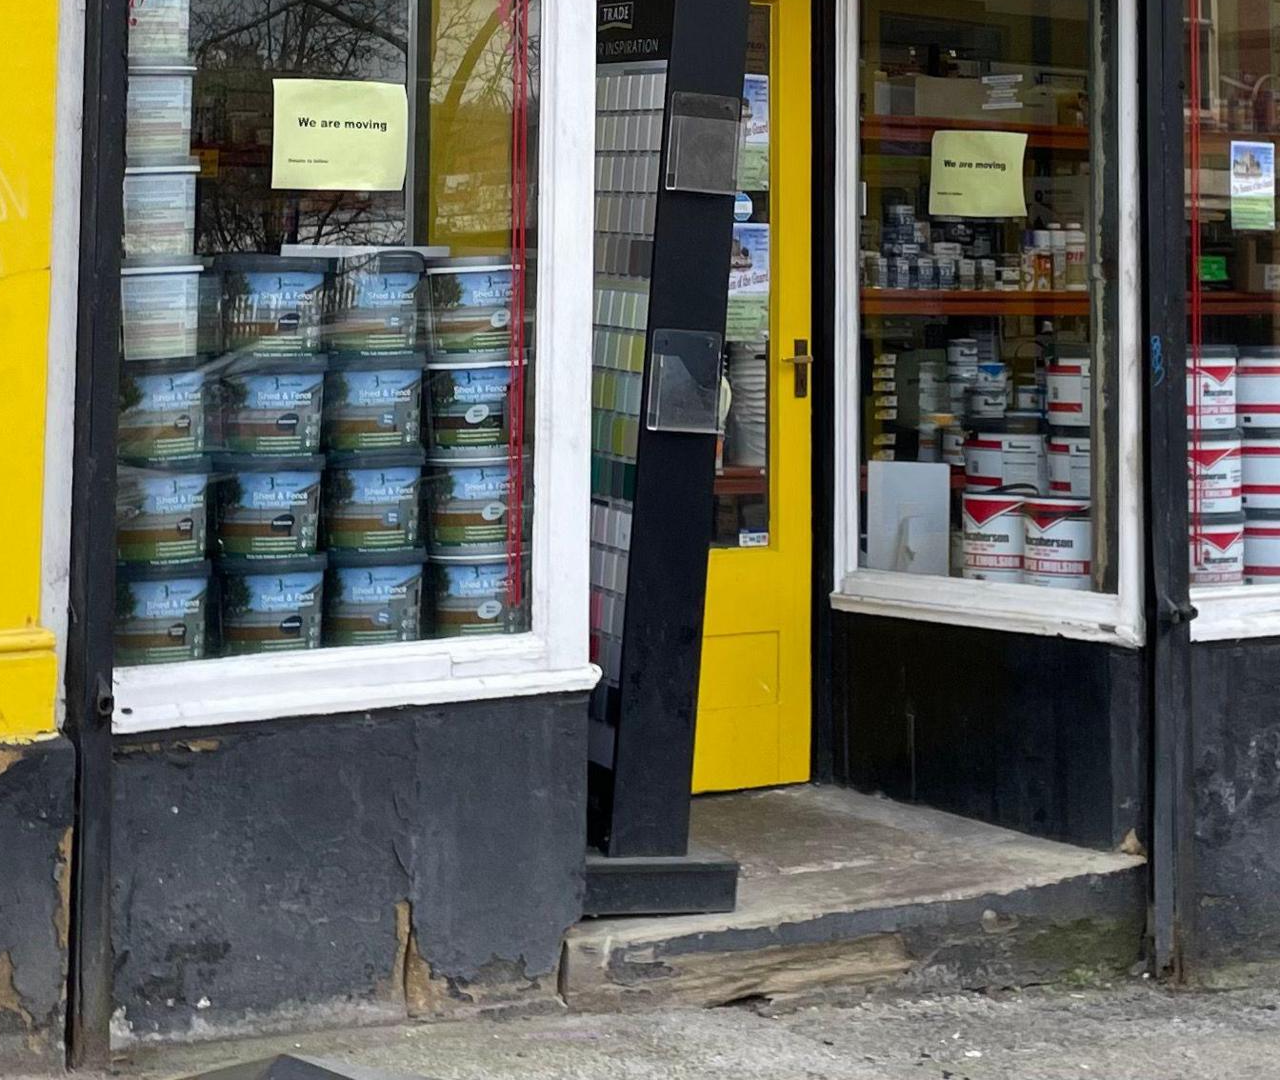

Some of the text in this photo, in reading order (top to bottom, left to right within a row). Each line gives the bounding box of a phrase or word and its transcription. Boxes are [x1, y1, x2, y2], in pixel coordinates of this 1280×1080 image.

[603, 6, 629, 21] TRADE
[606, 38, 659, 55] INSPIRATION
[298, 117, 388, 132] We are moving
[943, 159, 1007, 171] We are moving
